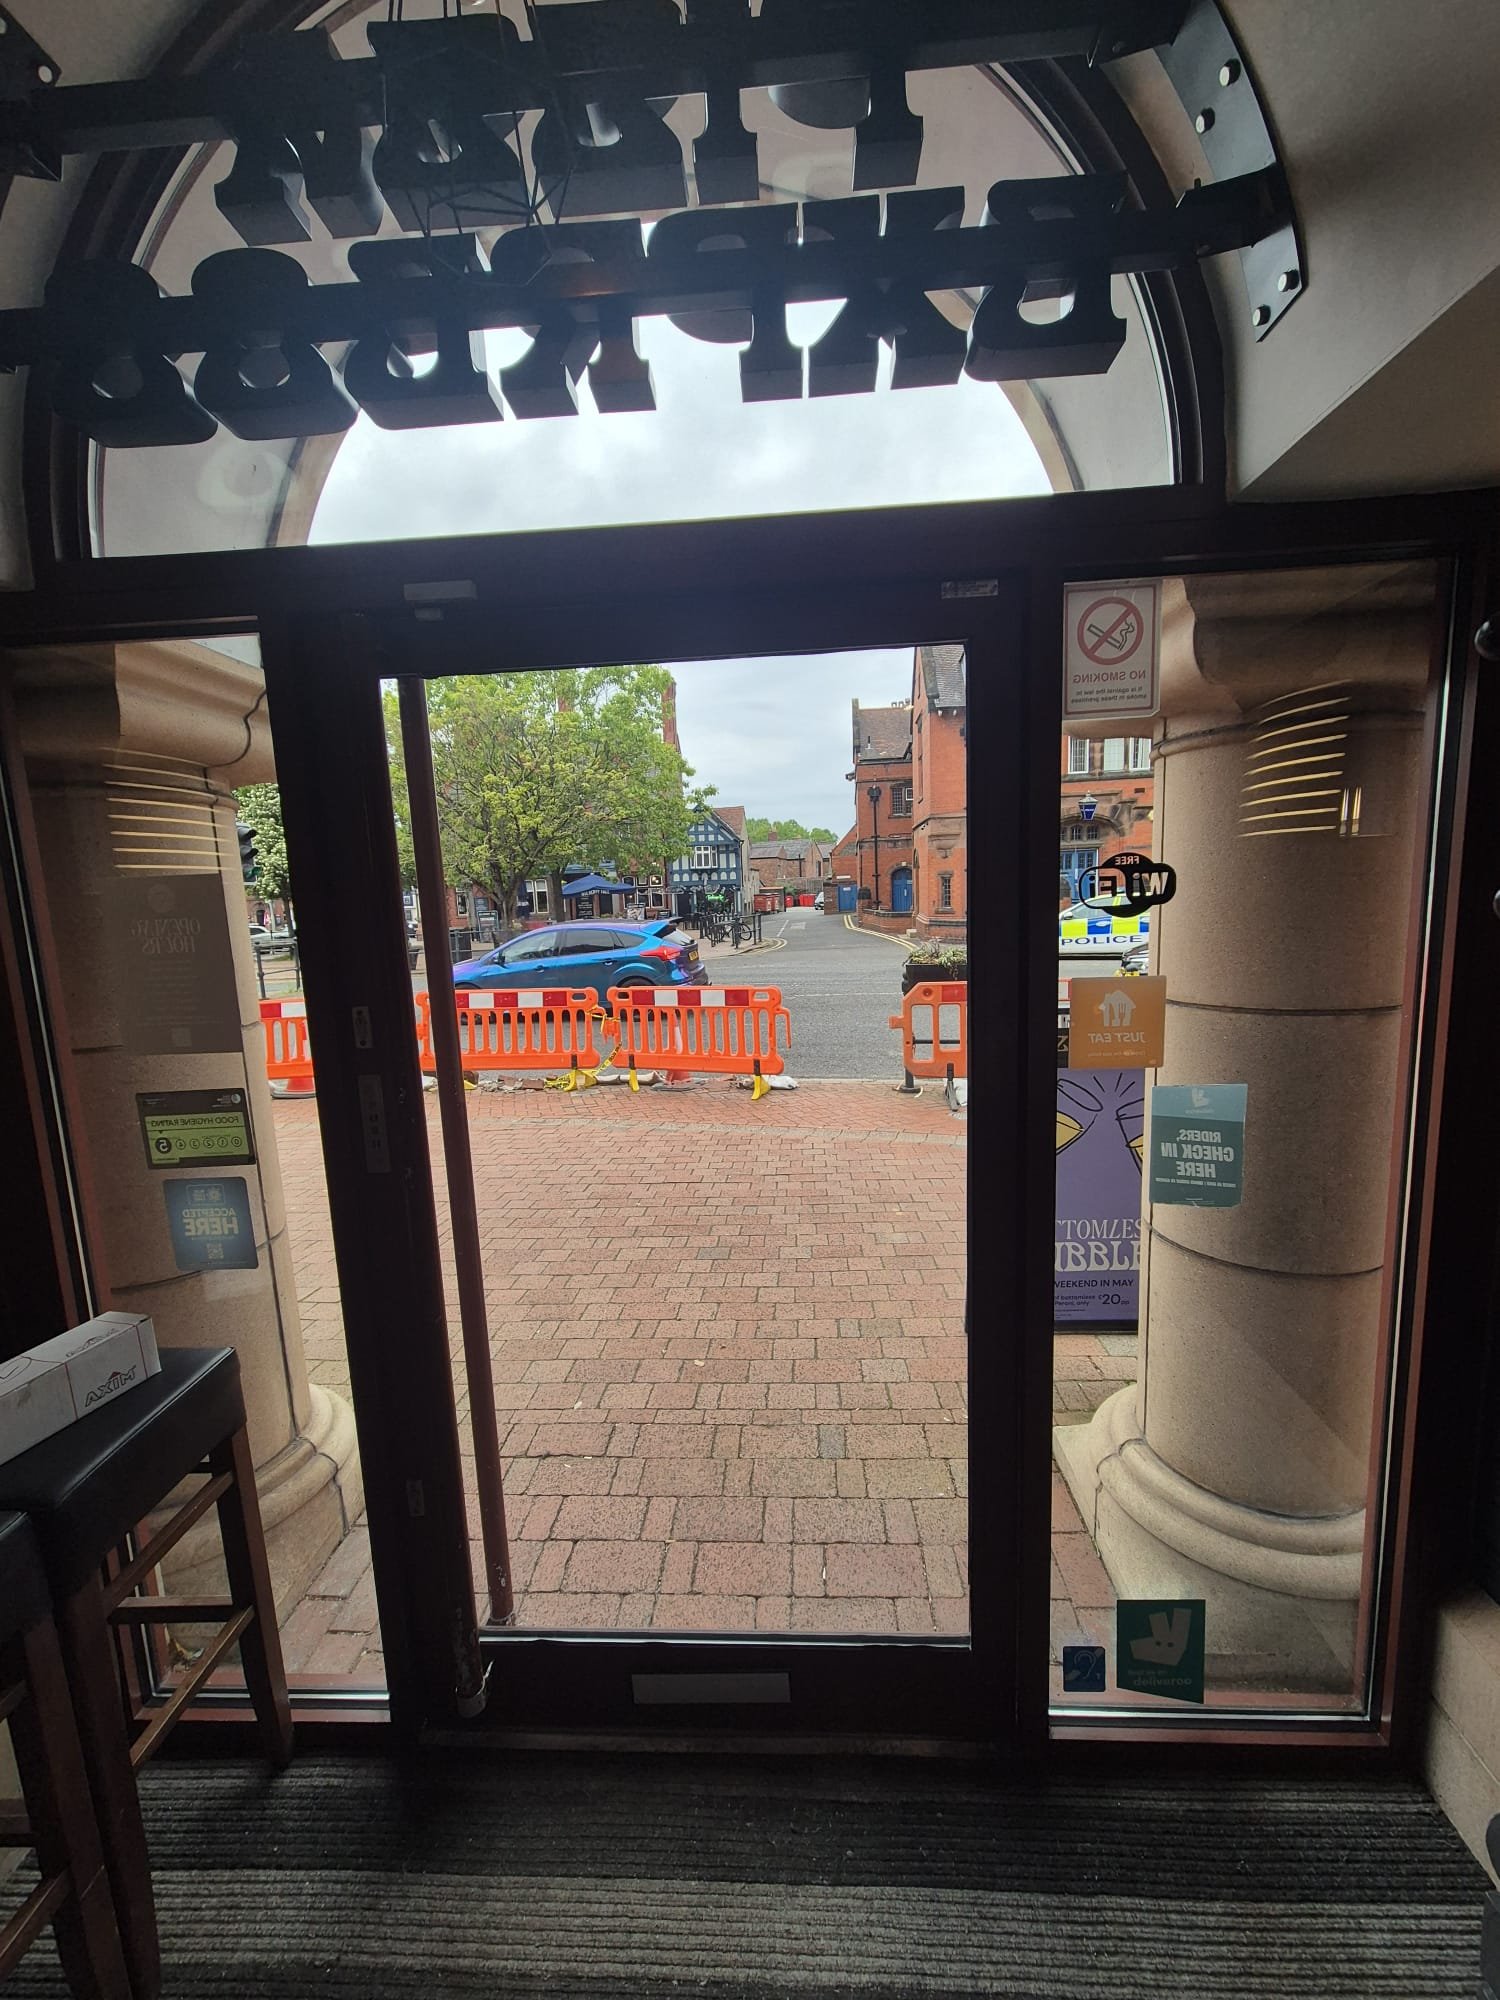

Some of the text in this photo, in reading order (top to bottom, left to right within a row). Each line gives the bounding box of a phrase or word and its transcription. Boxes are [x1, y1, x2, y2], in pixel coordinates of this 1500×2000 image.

[1061, 935, 1144, 946] POLICE
[1112, 1279, 1134, 1287] MAY
[84, 1366, 137, 1407] AXIM
[1133, 1675, 1192, 1689] deliveroo
